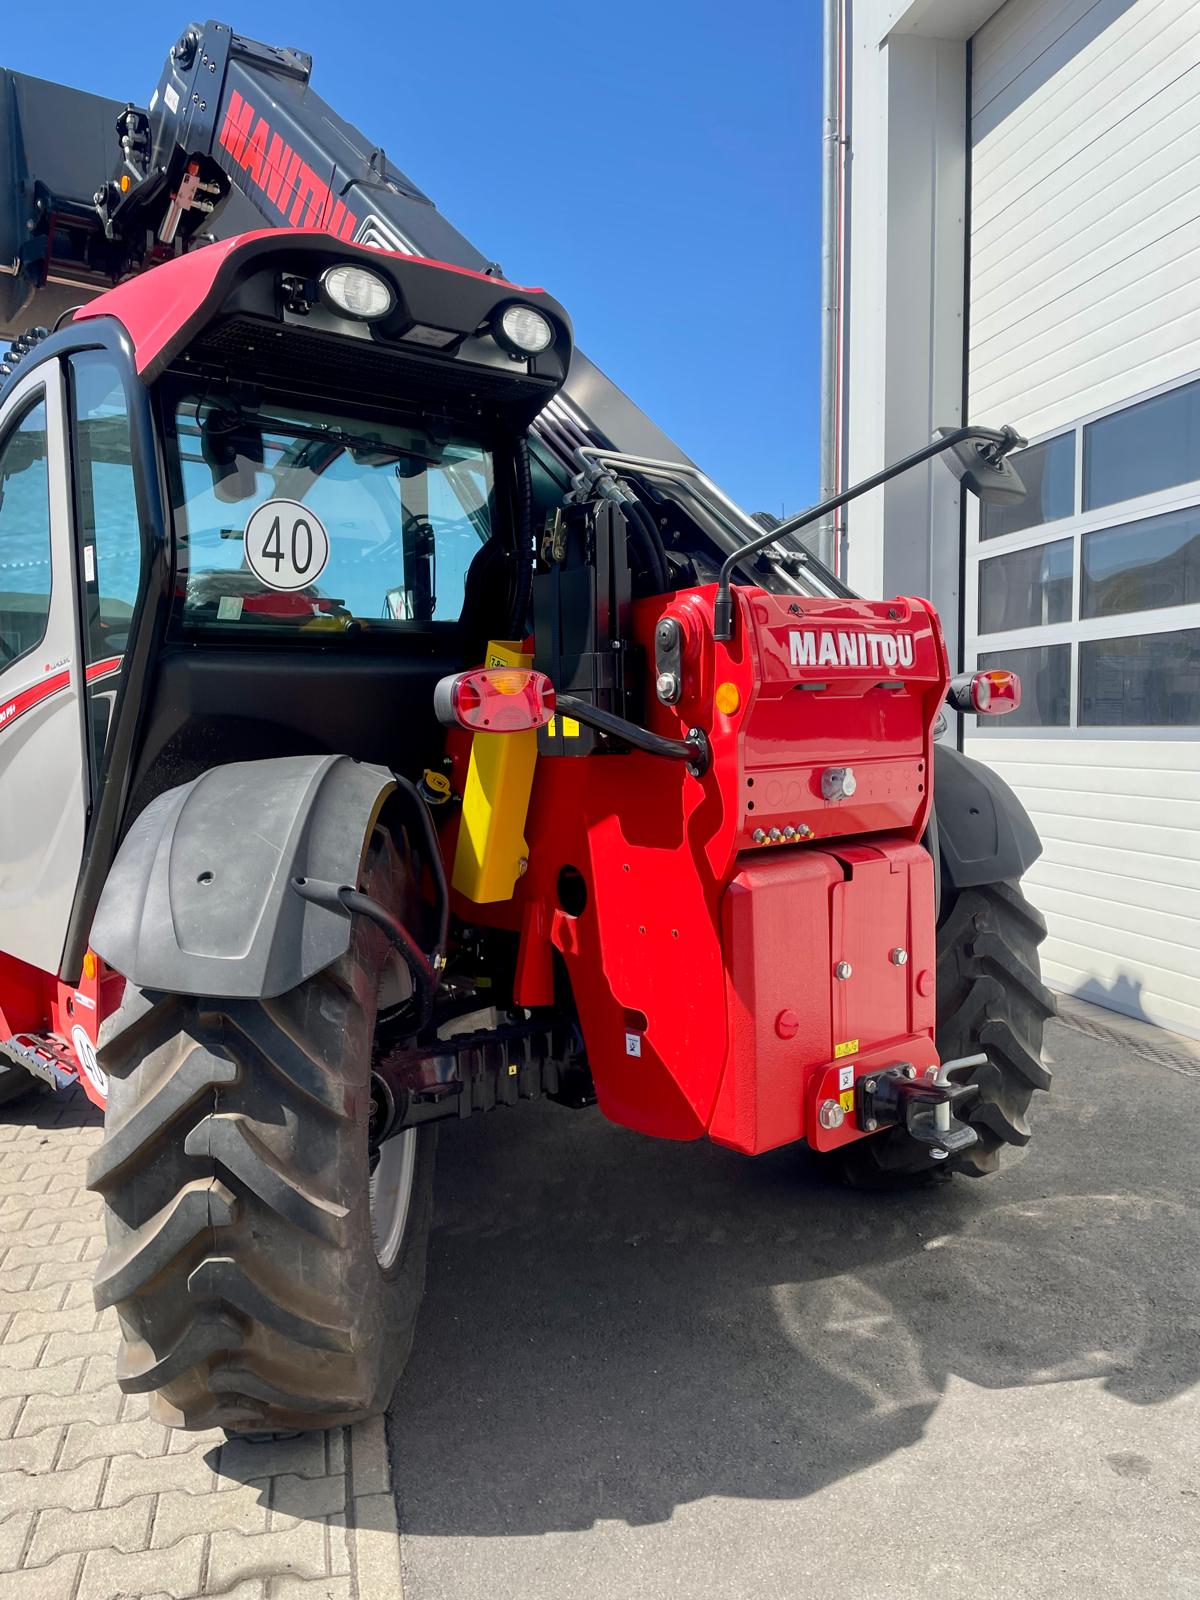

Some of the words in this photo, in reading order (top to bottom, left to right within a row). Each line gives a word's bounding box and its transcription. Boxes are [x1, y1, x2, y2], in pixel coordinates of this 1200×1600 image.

[220, 89, 357, 241] MANITOU
[261, 515, 313, 574] 40
[788, 631, 913, 667] MANITOU
